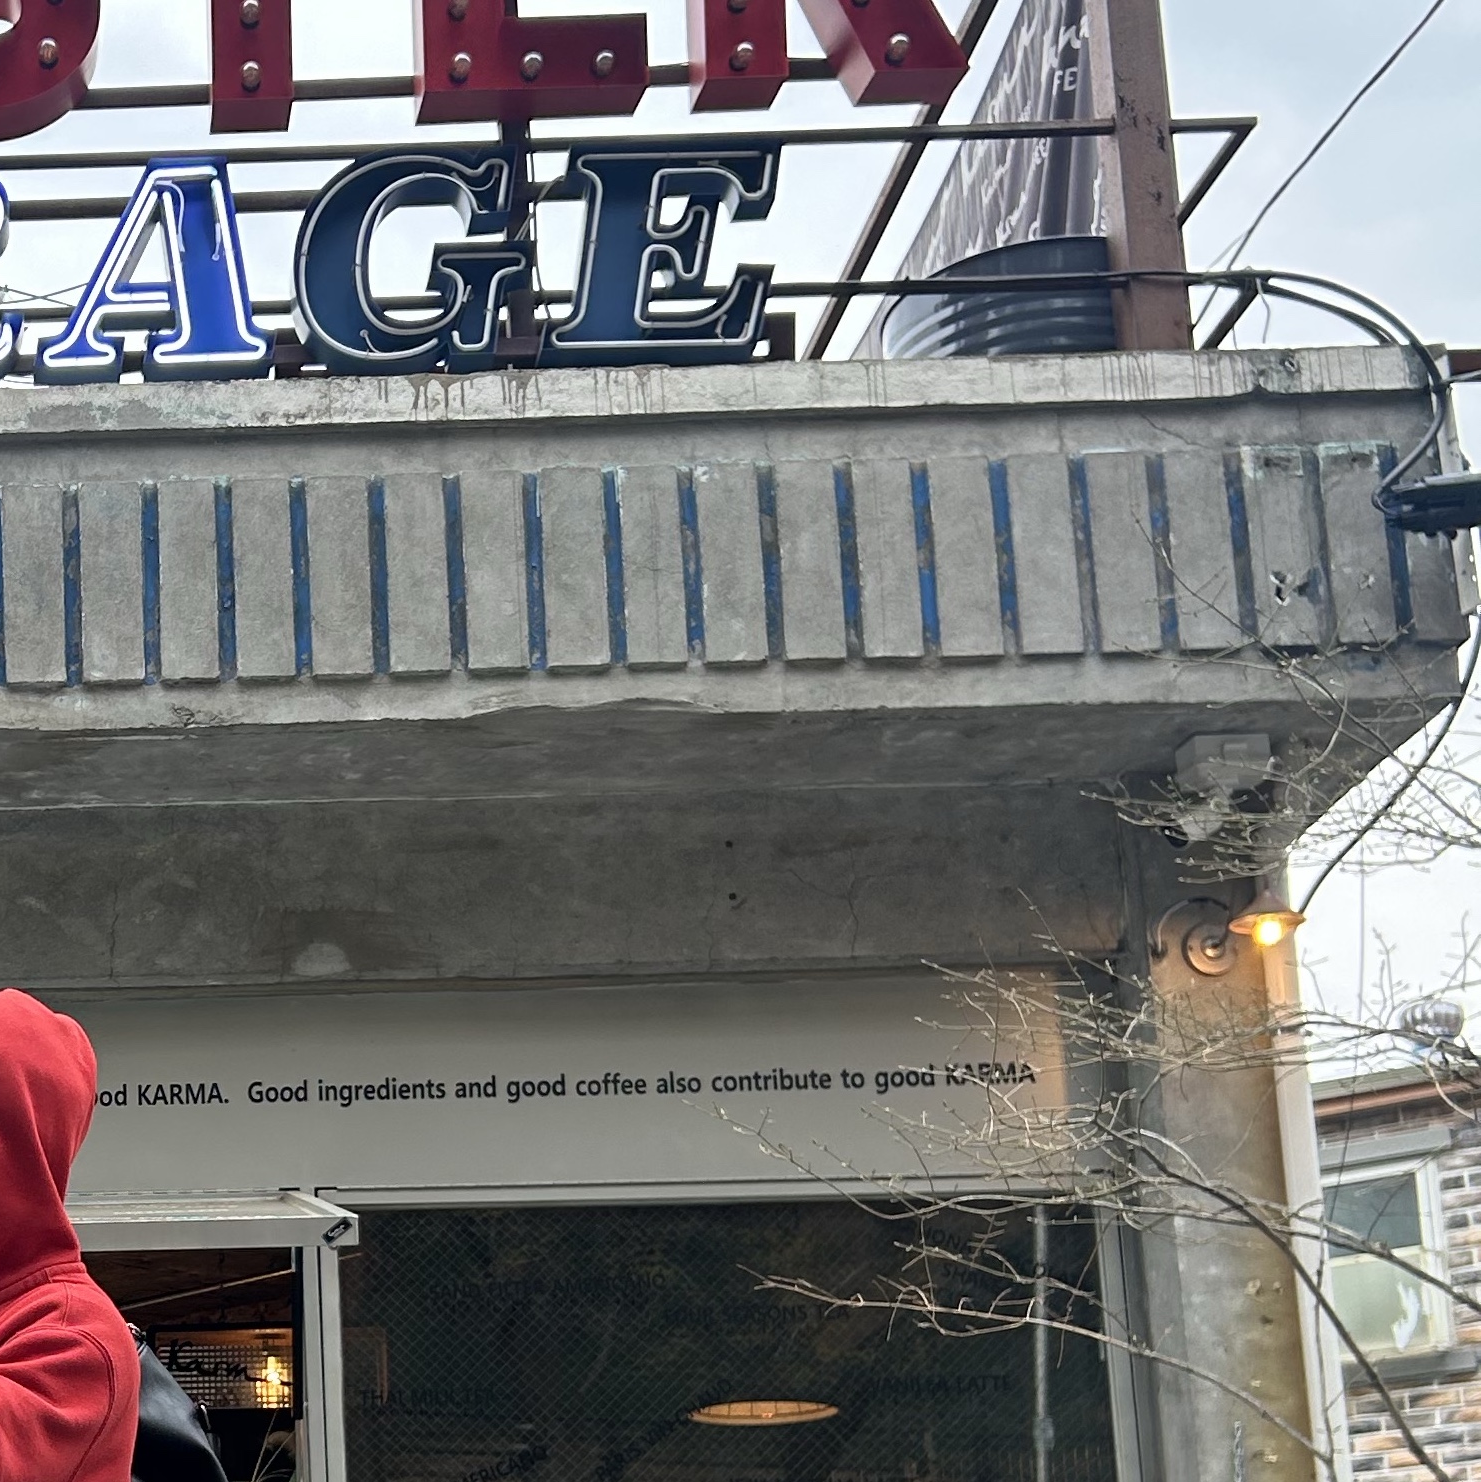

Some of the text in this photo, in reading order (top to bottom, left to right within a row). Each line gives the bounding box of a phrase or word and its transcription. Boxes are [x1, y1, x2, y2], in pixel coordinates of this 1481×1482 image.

[137, 1083, 230, 1106] KARMA.
[247, 1080, 309, 1103] Good
[318, 1077, 447, 1108] ingredients
[454, 1075, 497, 1099] and
[506, 1073, 567, 1104] good
[575, 1072, 648, 1096] coffee
[656, 1070, 703, 1094] also
[711, 1067, 833, 1093] contribute
[839, 1068, 866, 1089] to
[875, 1064, 934, 1095] good
